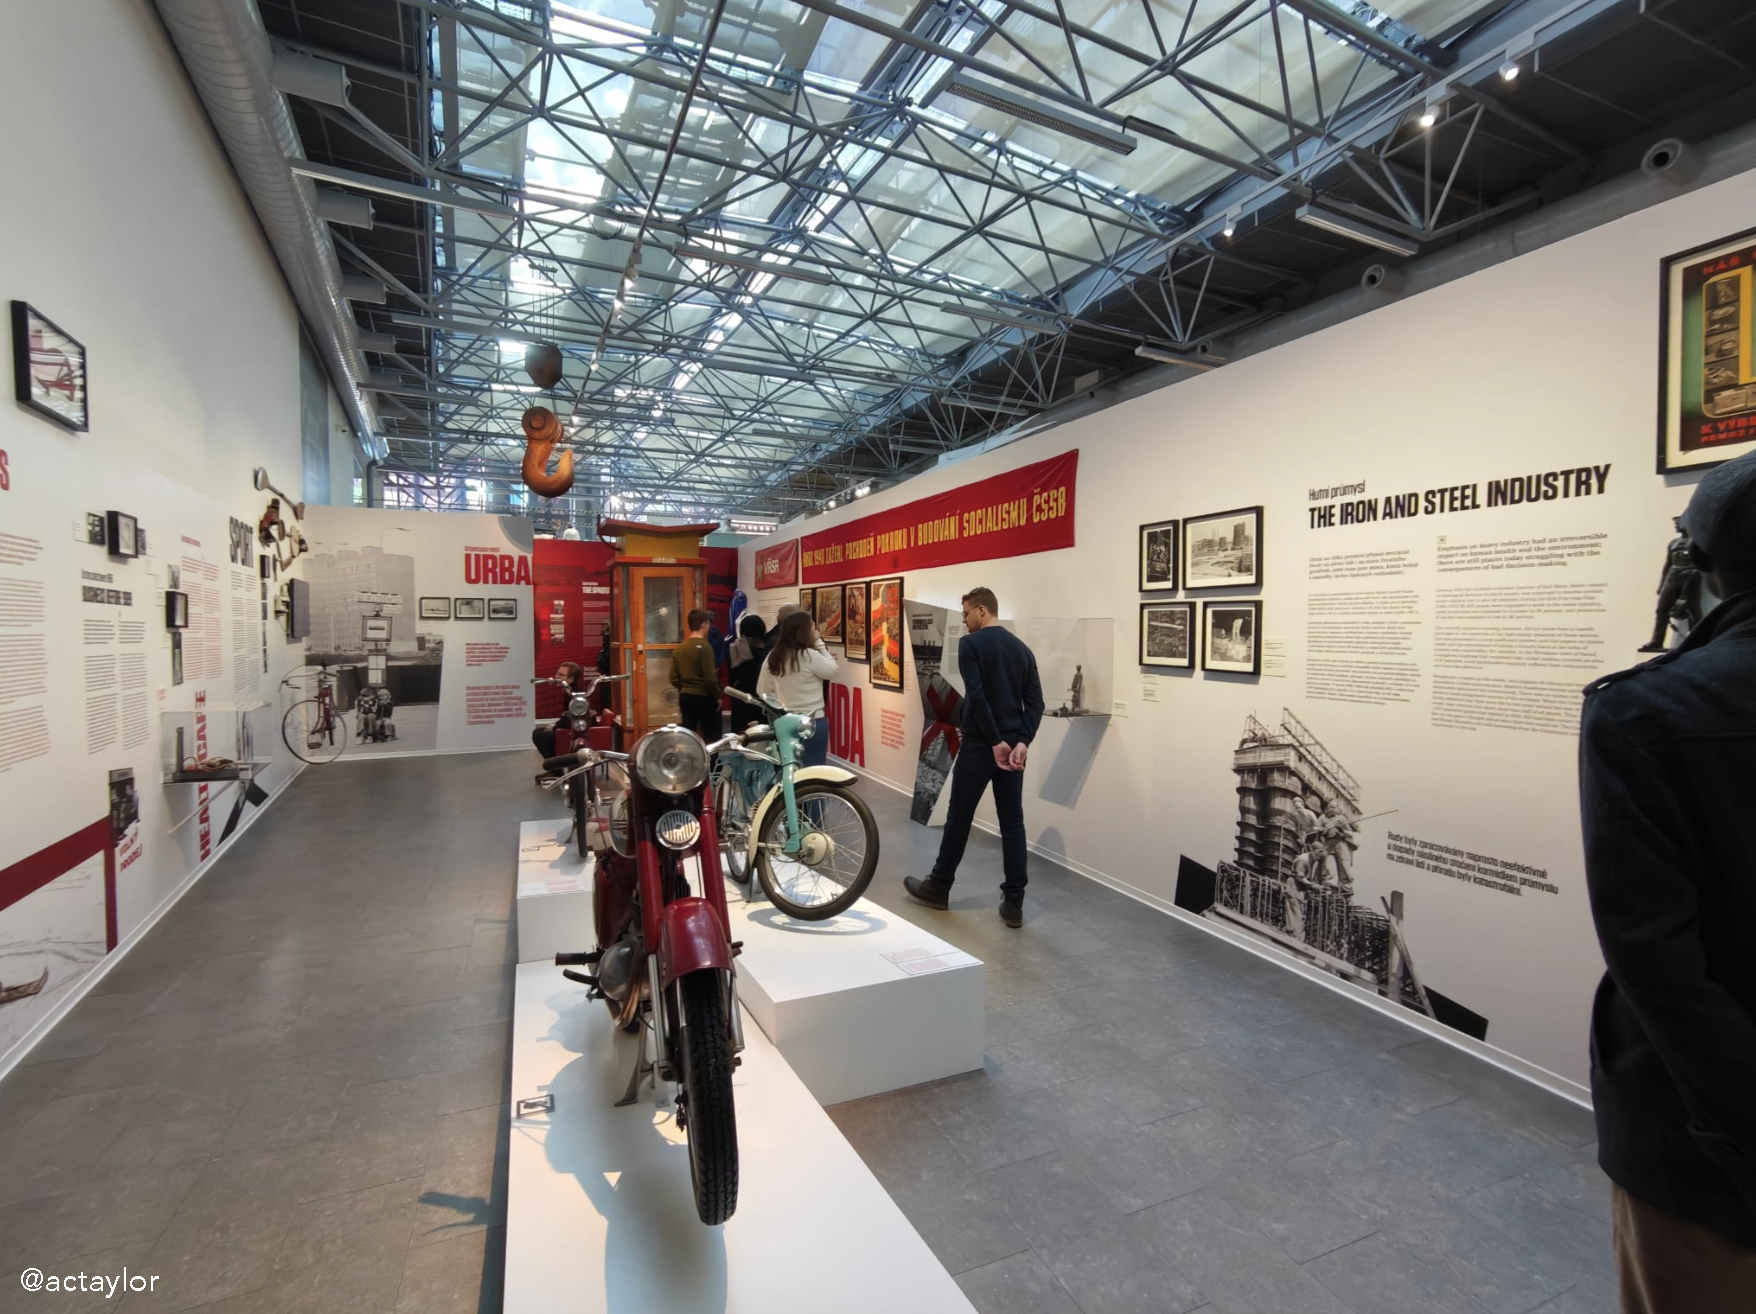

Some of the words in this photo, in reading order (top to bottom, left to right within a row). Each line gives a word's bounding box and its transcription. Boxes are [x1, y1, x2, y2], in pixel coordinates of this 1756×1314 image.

[910, 526, 915, 547] V
[918, 510, 960, 546] BUDOVÁNÍ
[963, 497, 1027, 537] SOCIALISMU
[1032, 486, 1067, 523] ČSSR
[1308, 504, 1336, 529] THE
[1339, 498, 1377, 526] IRON
[1382, 492, 1419, 521] AND
[1424, 483, 1481, 515] STEEL
[1487, 463, 1612, 508] INDUSTRY
[230, 516, 253, 569] SPORT
[465, 553, 534, 585] URBA
